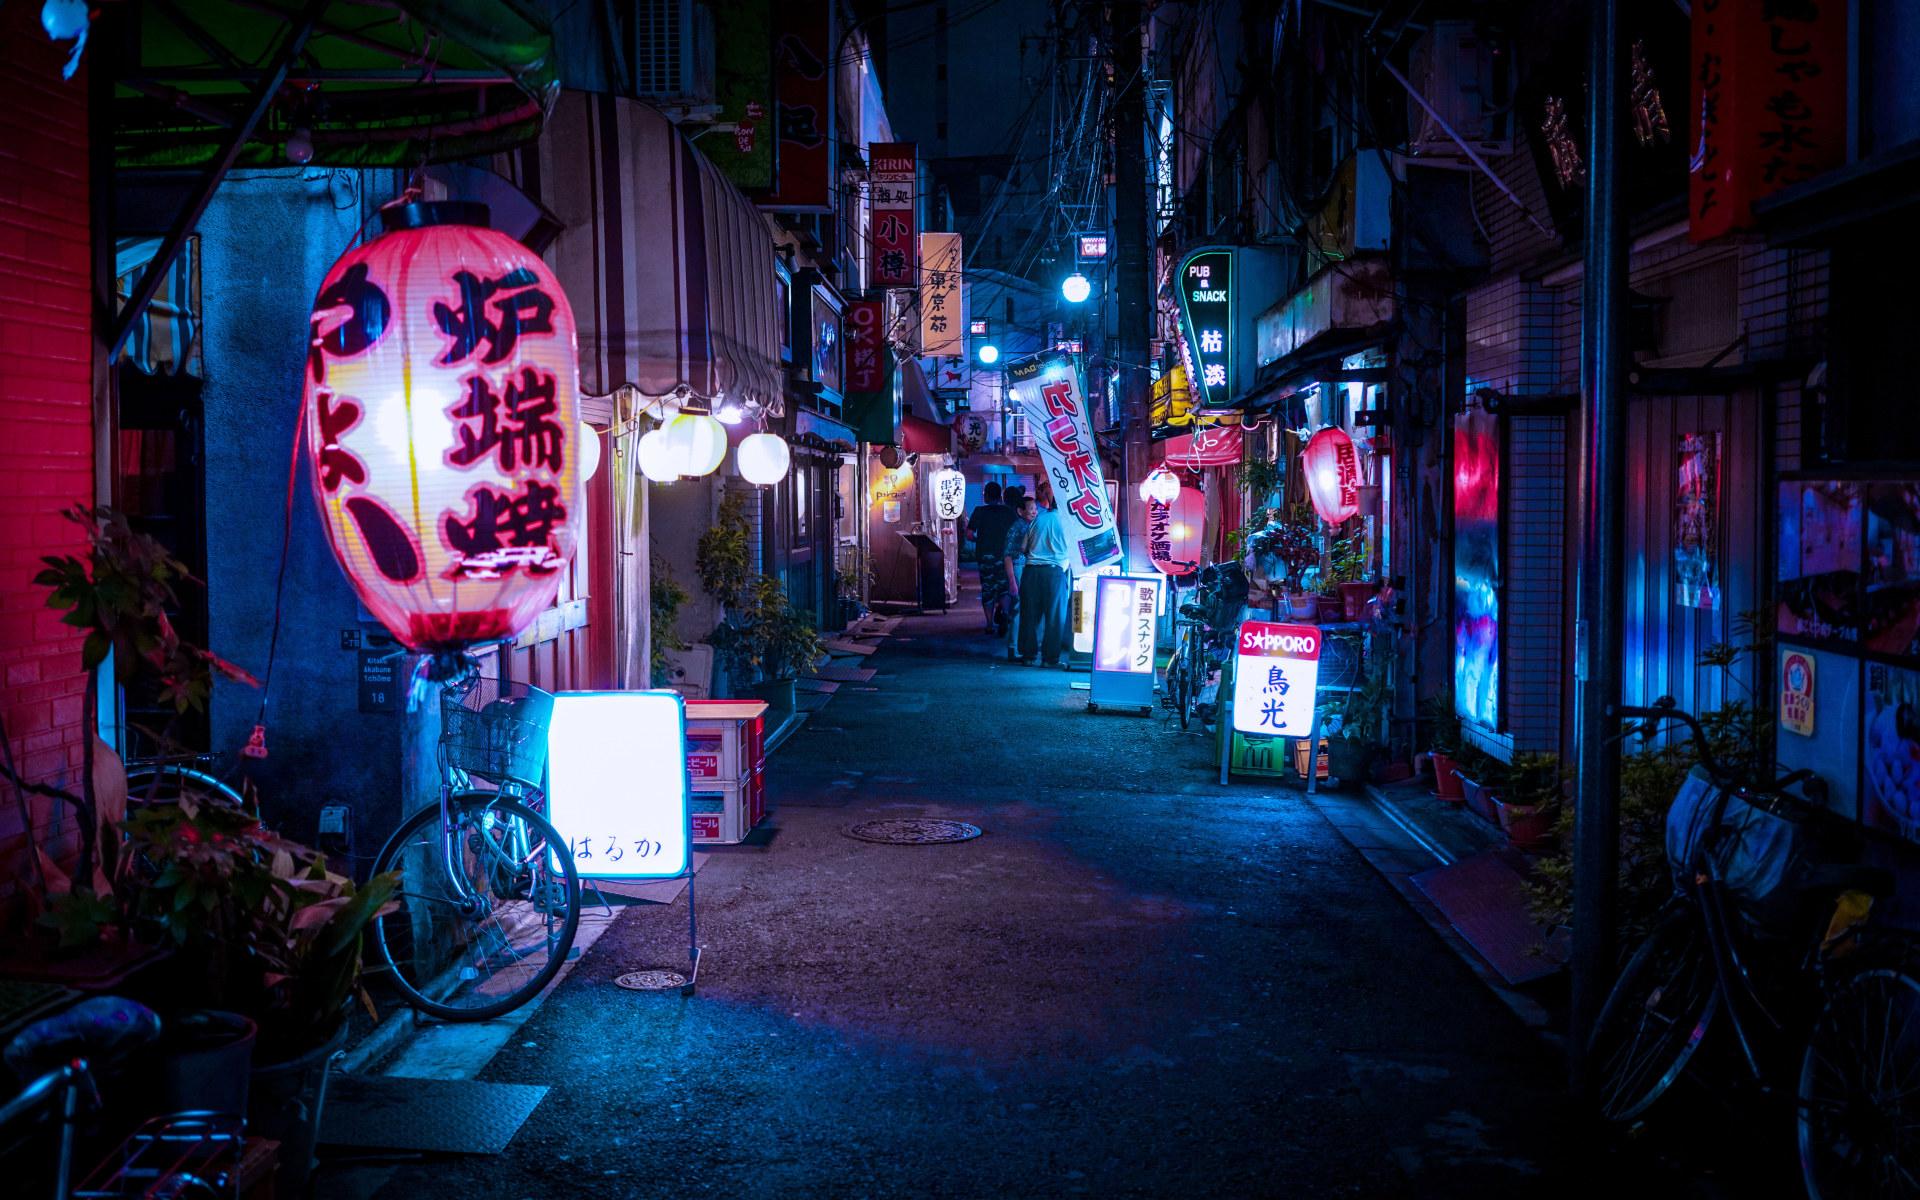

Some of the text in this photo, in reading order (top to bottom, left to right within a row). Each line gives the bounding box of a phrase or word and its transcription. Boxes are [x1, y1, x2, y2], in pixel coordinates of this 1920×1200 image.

[873, 158, 913, 170] KIRIN
[878, 214, 909, 279] 小樽
[1189, 266, 1210, 278] PUB
[1200, 279, 1210, 288] &
[930, 271, 947, 333] 東京苑
[1193, 290, 1227, 302] SNACK
[1201, 330, 1226, 386] 枯淡
[433, 266, 566, 578] 炉端焼
[1136, 587, 1155, 667] 歌声スナック
[372, 692, 385, 703] 18
[1260, 665, 1290, 729] 鳥光
[570, 836, 662, 862] はるか
